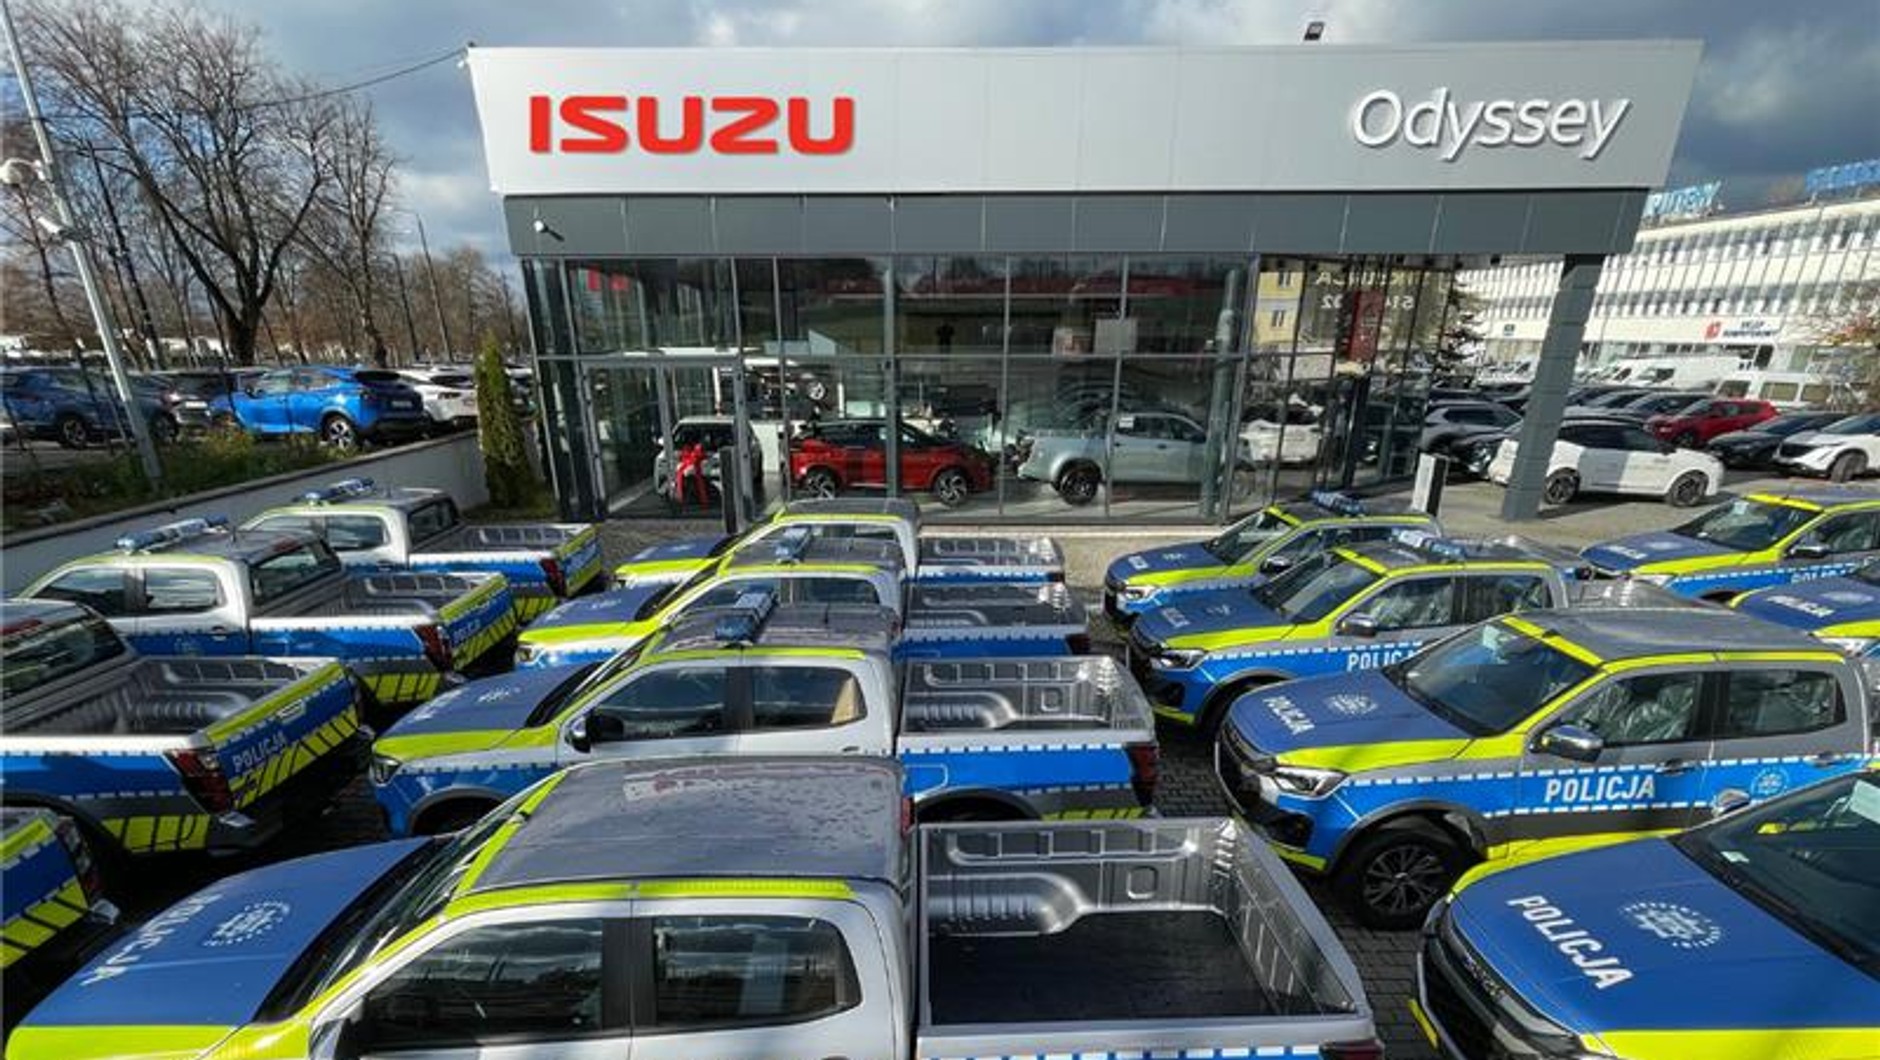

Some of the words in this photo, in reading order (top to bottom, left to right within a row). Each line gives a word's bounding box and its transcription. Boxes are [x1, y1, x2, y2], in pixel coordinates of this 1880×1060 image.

[530, 96, 855, 153] ISUZU
[1353, 86, 1631, 161] Odyssey
[231, 730, 289, 773] POLICJA
[1544, 774, 1656, 803] POLICJA
[1506, 895, 1635, 990] POLICJA
